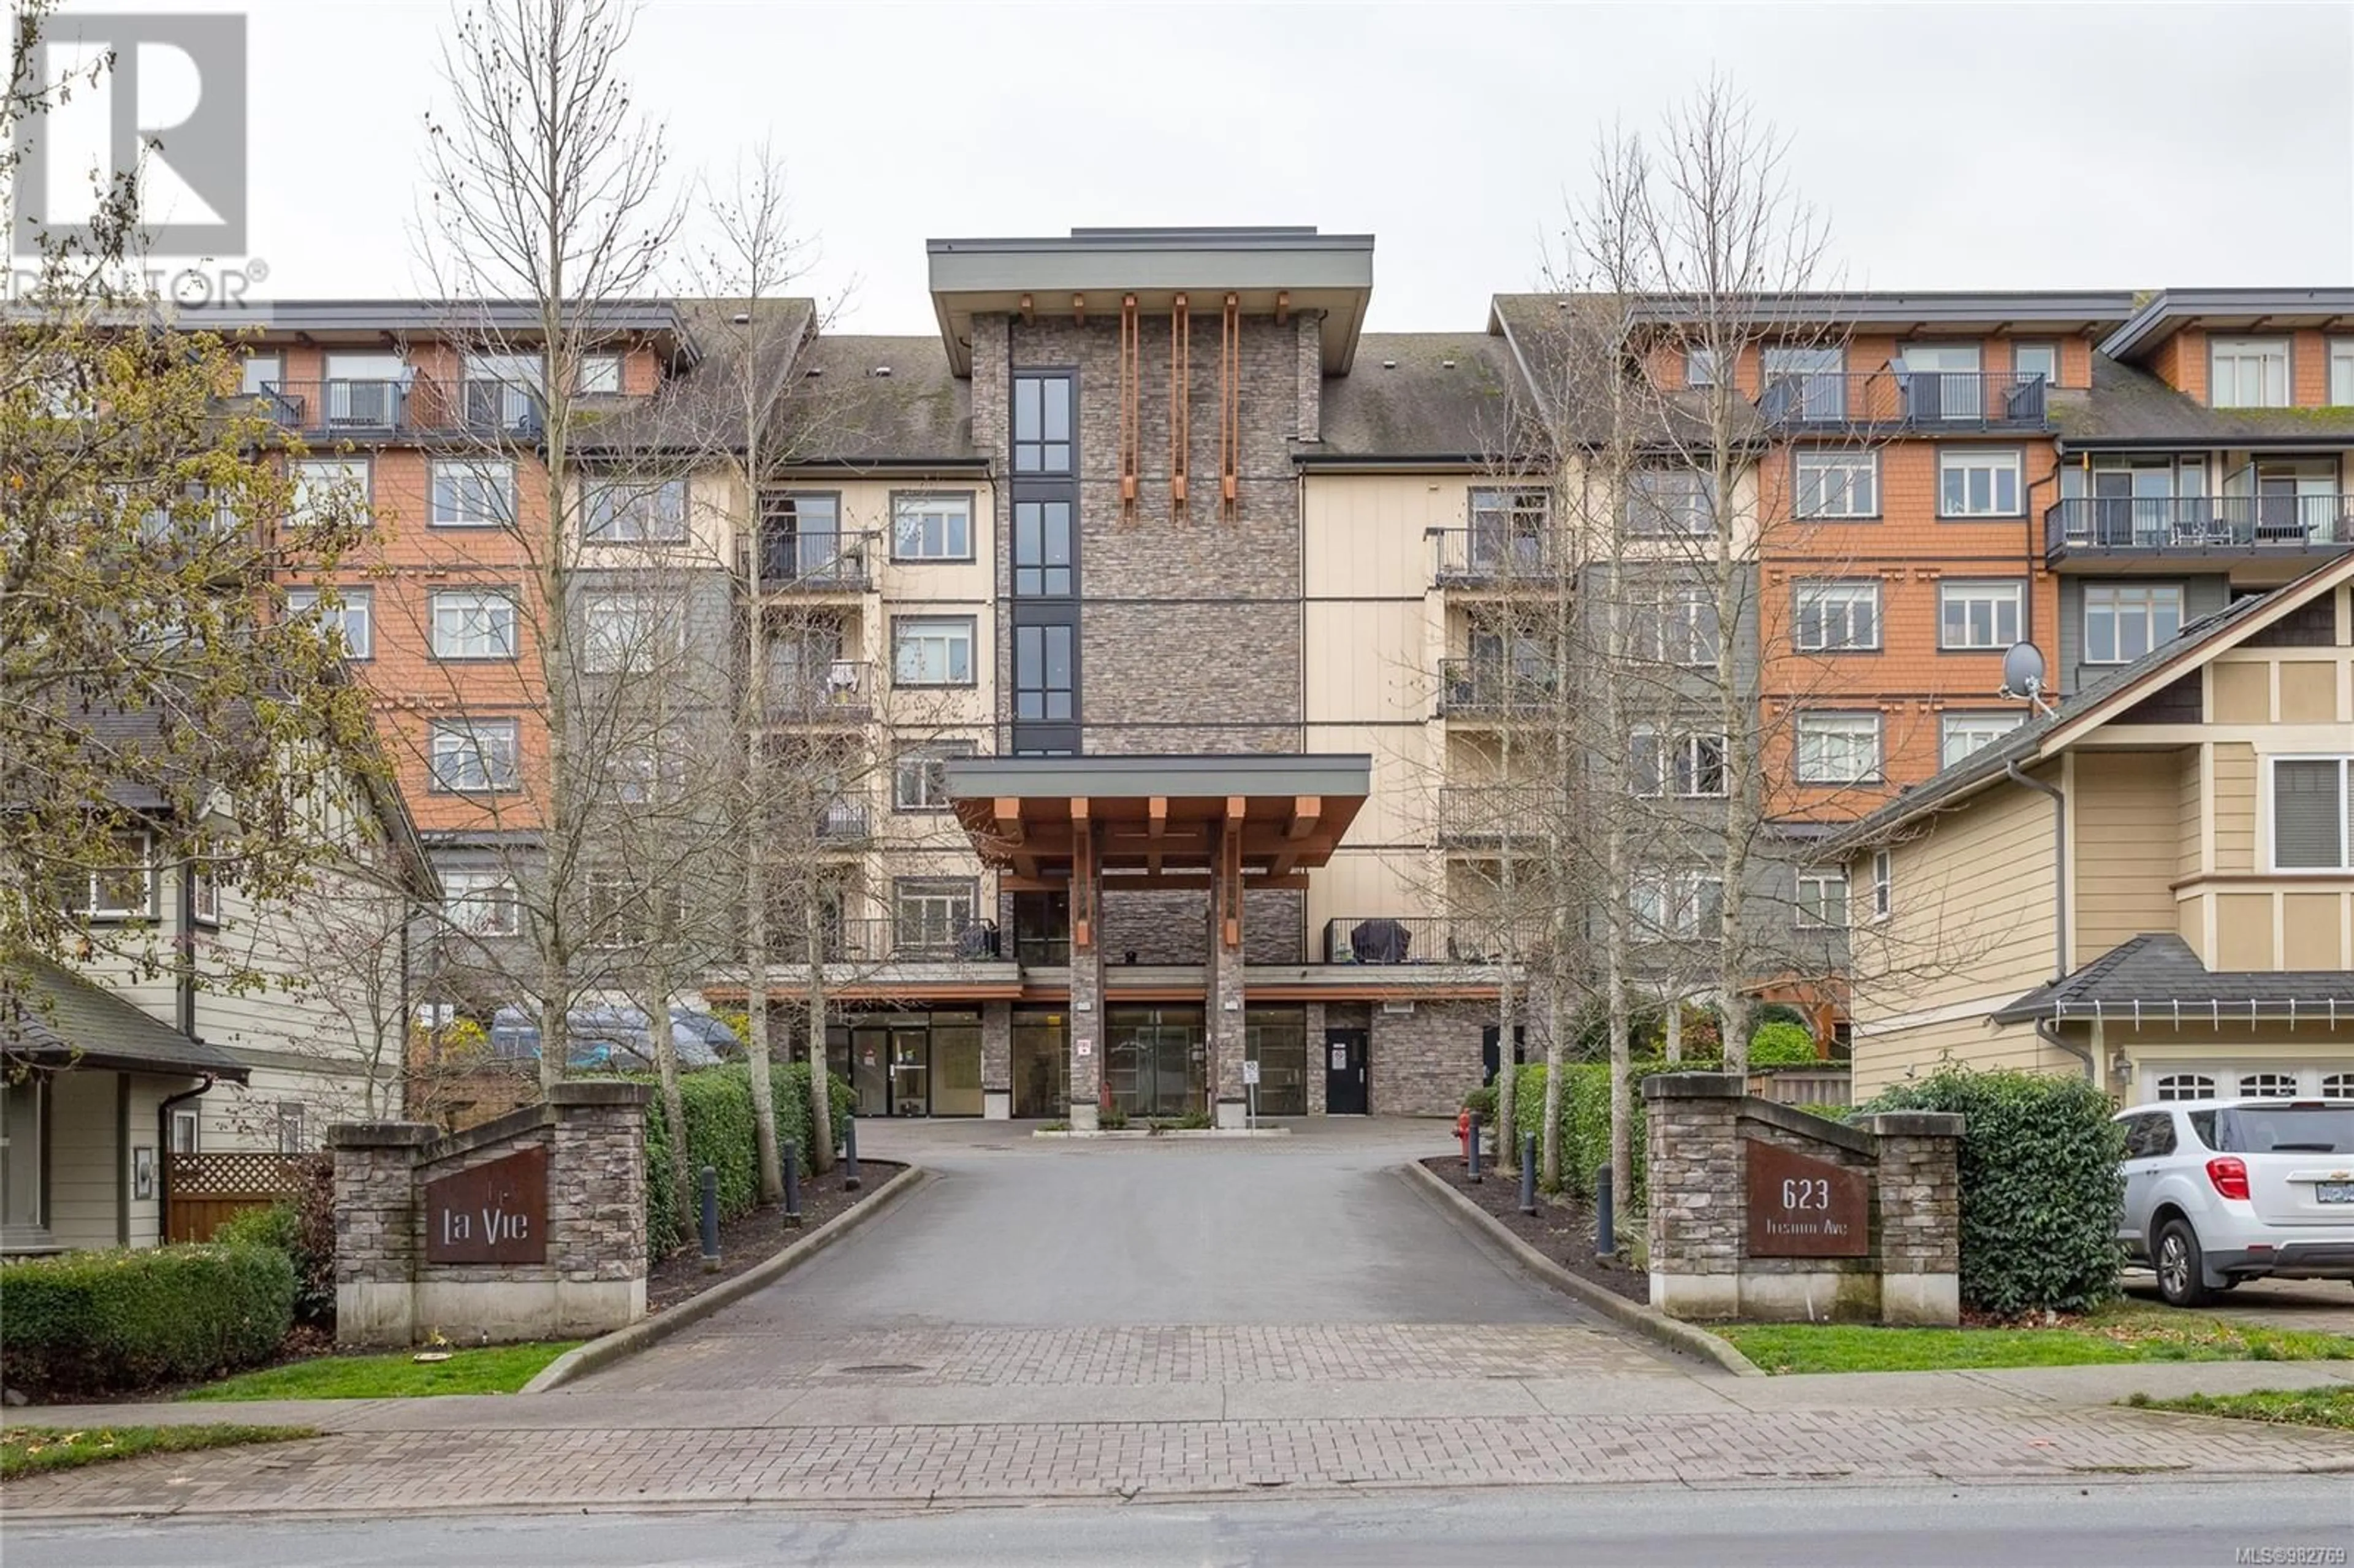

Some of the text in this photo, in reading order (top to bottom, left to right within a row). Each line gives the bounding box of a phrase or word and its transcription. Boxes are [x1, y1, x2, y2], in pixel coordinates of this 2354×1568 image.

[1783, 1178, 1829, 1210] 623
[444, 1208, 528, 1245] La Vie
